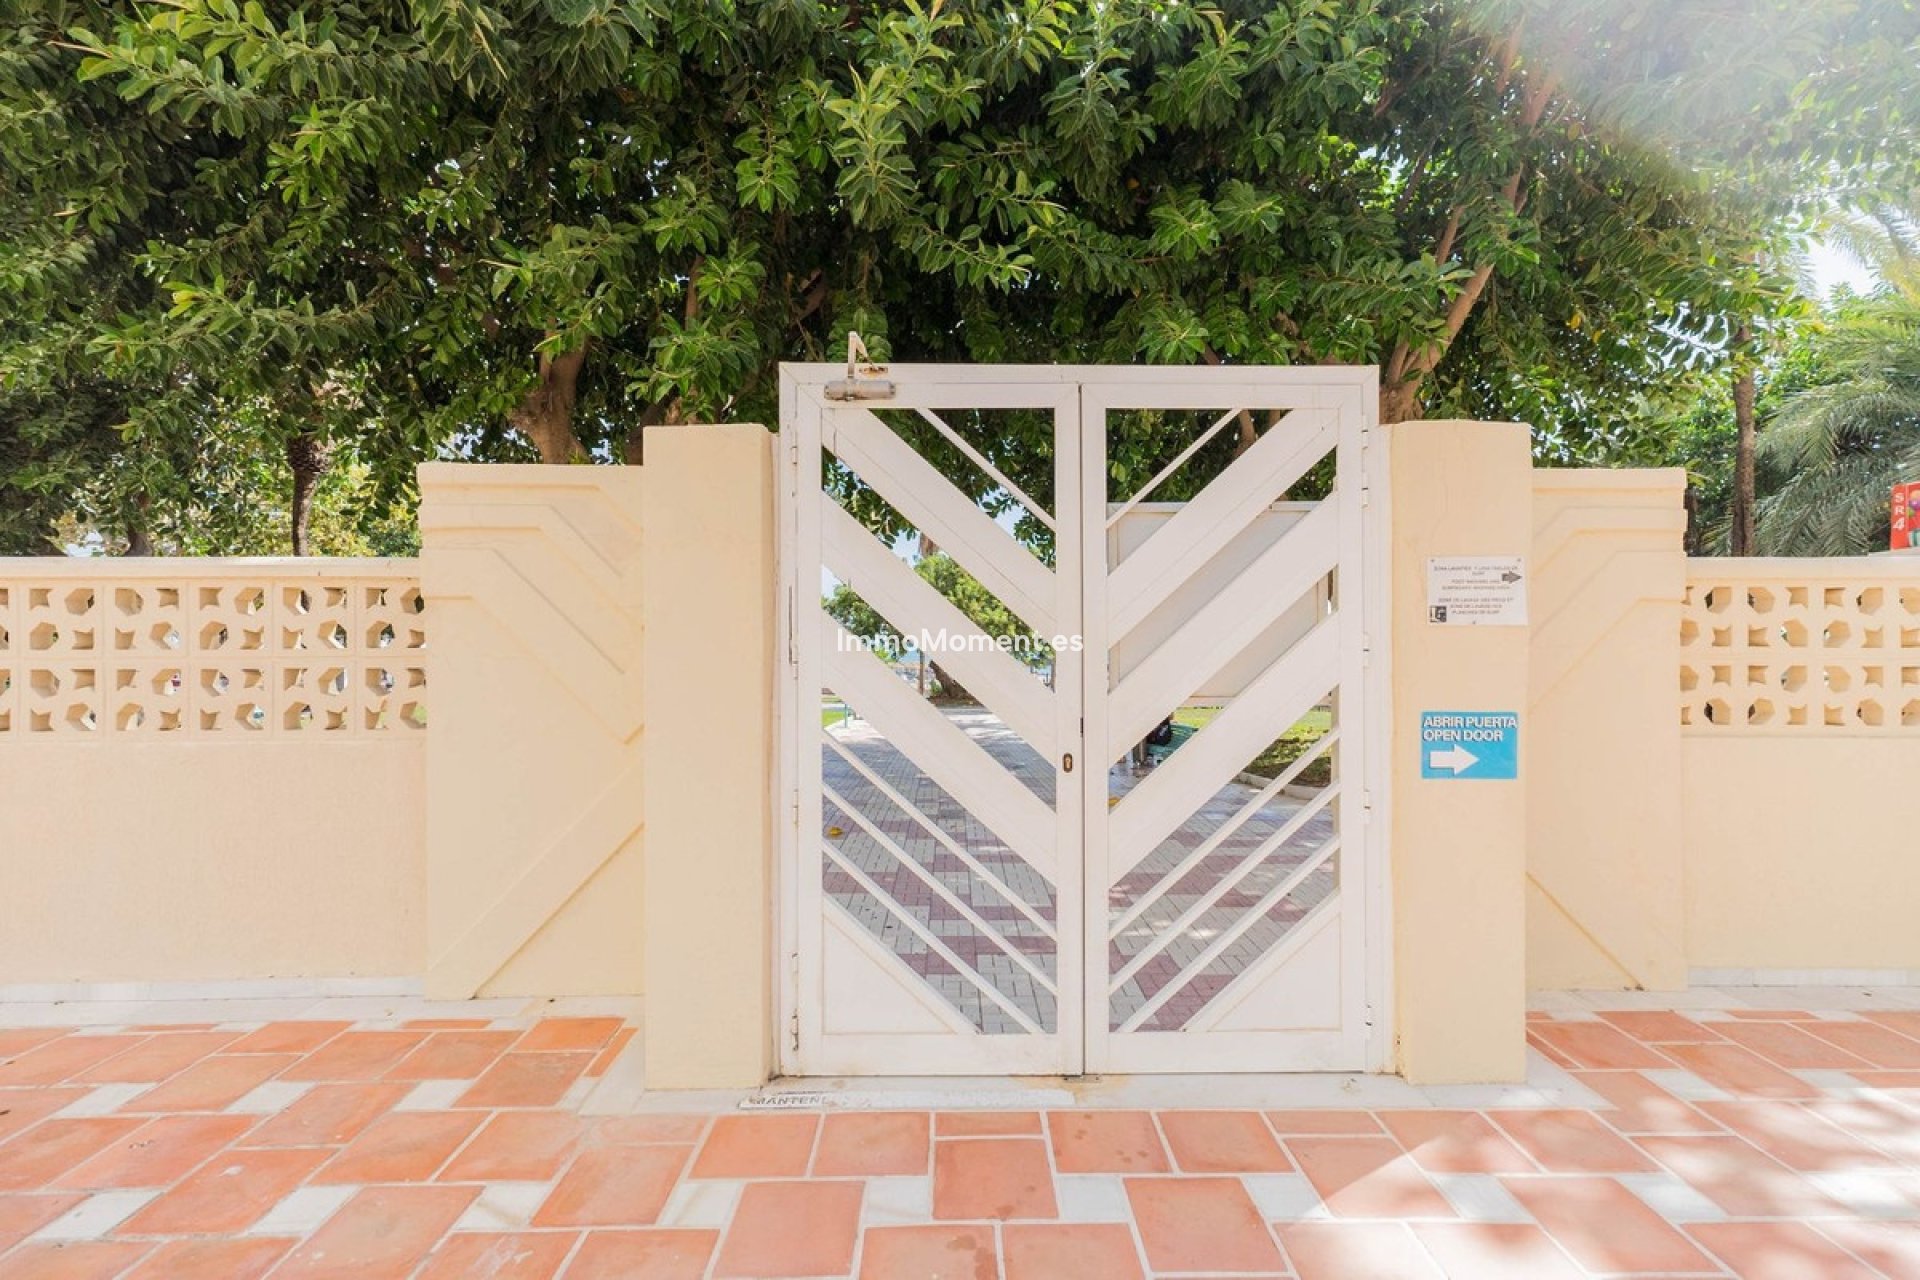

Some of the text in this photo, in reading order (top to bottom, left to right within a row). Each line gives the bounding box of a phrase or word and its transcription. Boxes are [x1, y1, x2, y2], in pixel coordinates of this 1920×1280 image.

[1423, 716, 1518, 728] ABRIR PUERTA
[1423, 729, 1503, 741] OPEN DOOR
